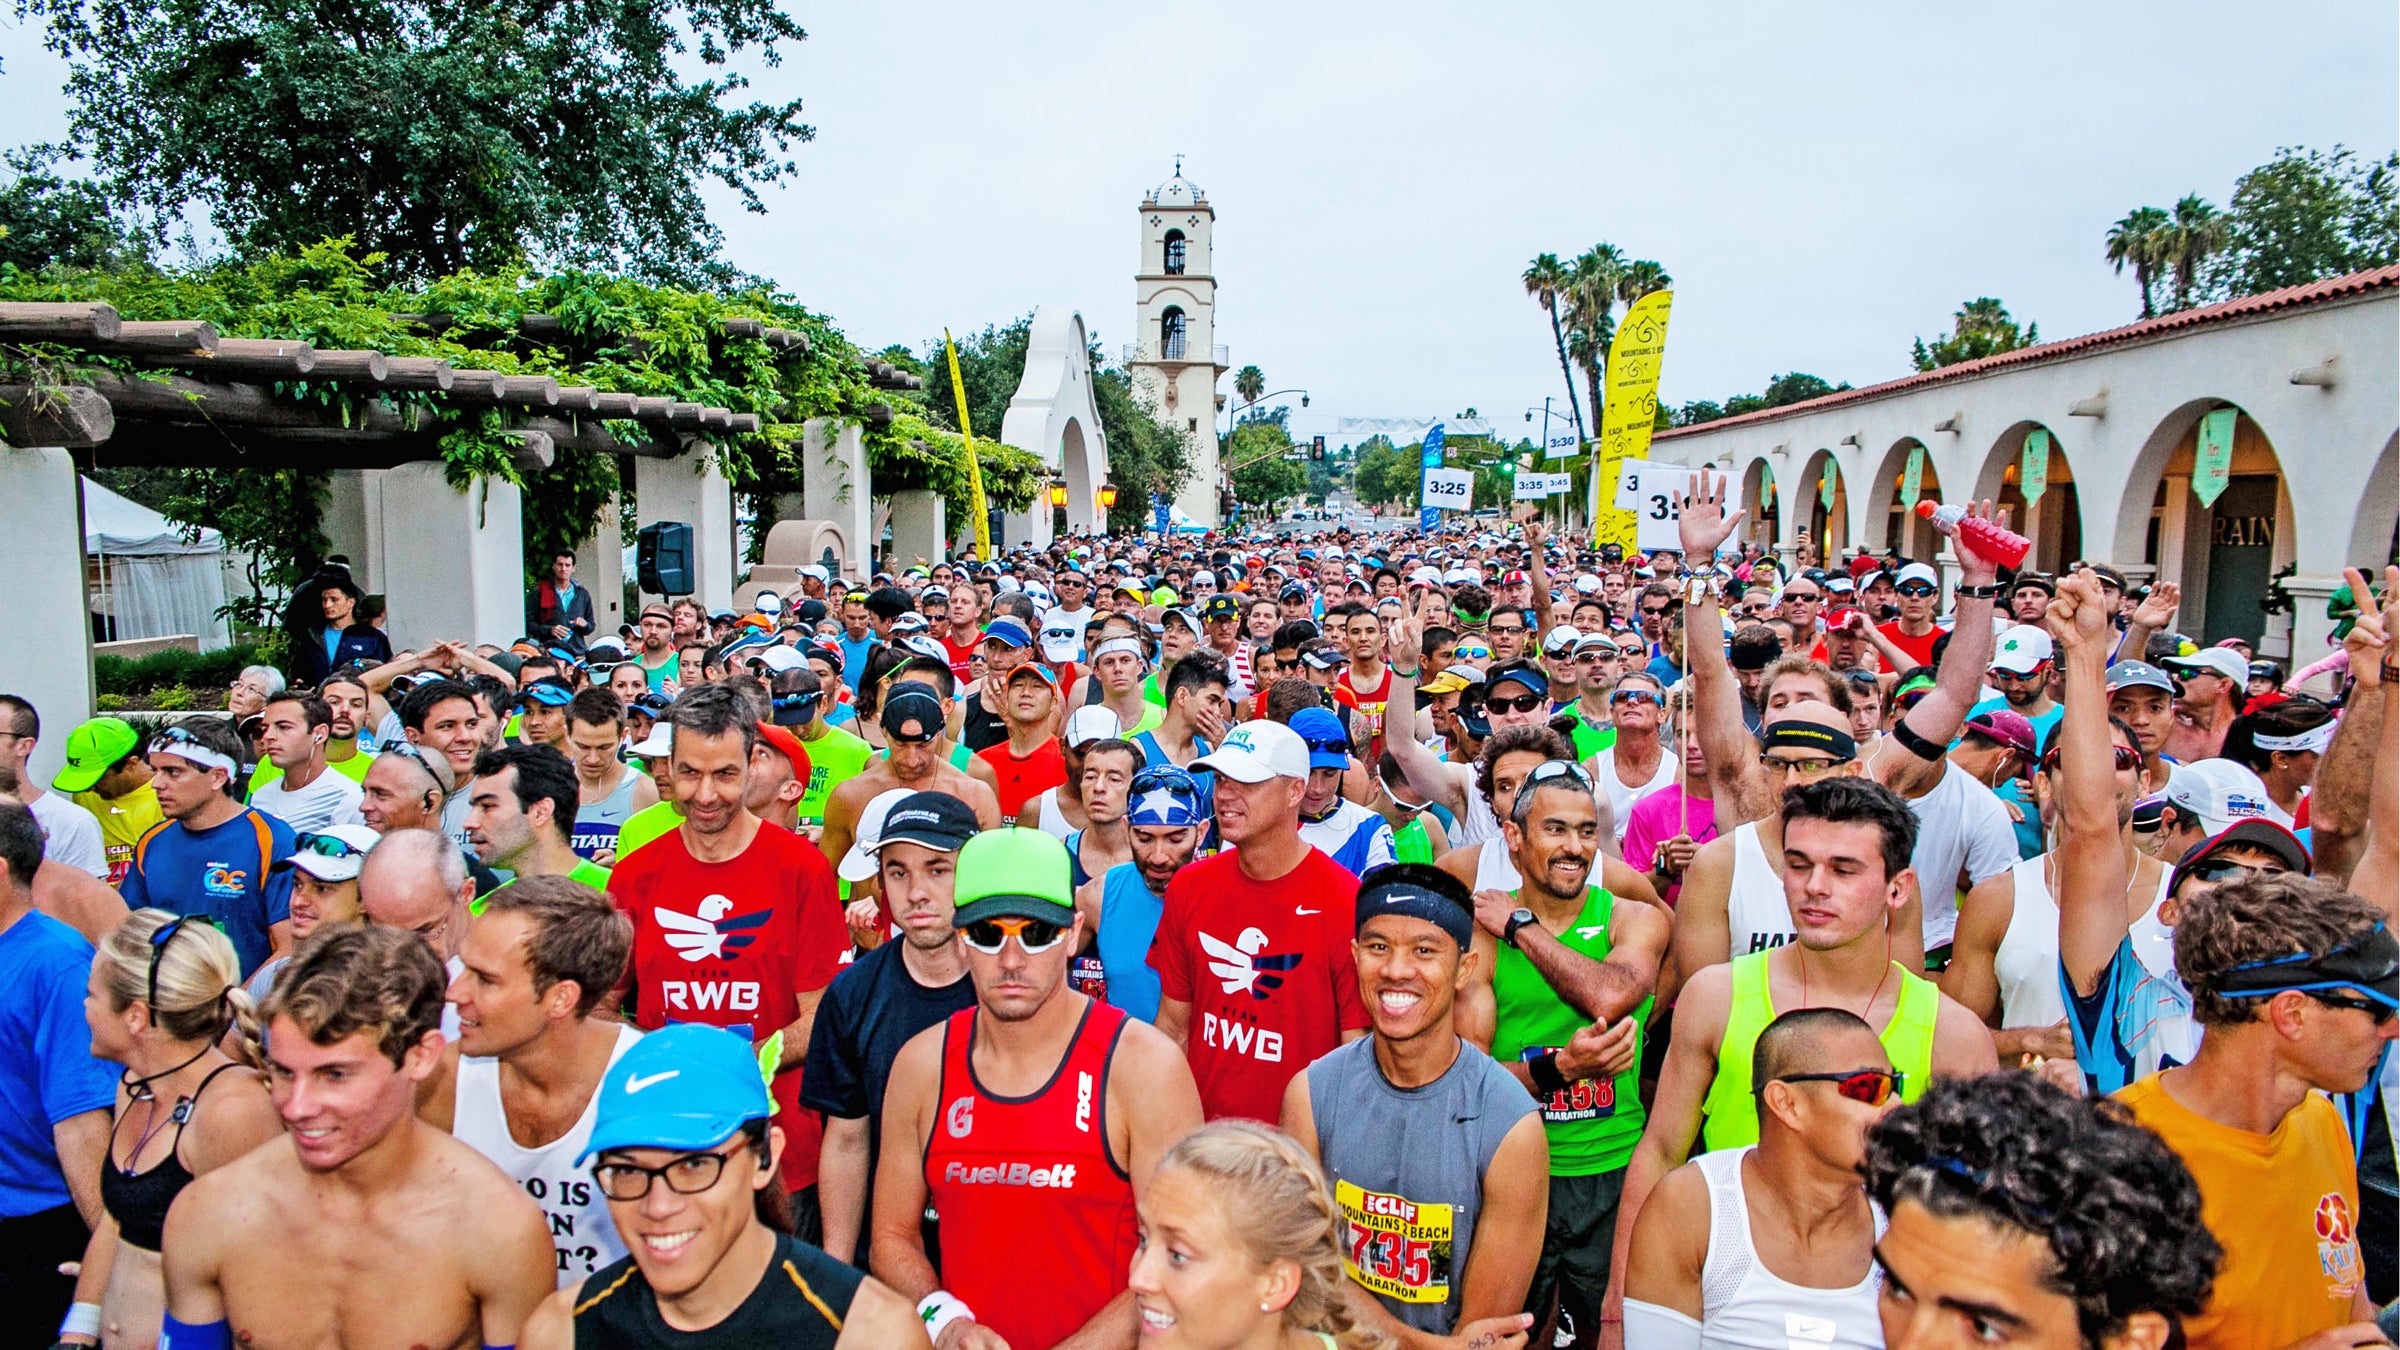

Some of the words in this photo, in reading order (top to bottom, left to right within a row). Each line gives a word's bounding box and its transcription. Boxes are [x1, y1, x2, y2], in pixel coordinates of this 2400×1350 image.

[1550, 436, 1575, 448] 3:30
[1430, 480, 1466, 496] 3:25
[1518, 480, 1543, 490] 3:35
[1549, 478, 1568, 487] 3:45
[1649, 494, 1725, 521] 3:
[690, 969, 729, 978] TEAM
[662, 981, 760, 1011] RWB
[1203, 1011, 1283, 1063] RWB
[1542, 1074, 1614, 1112] 158
[1545, 1109, 1596, 1121] MARATHON
[944, 1161, 1077, 1189] FuelBelt
[559, 1181, 591, 1207] IS
[1403, 1222, 1408, 1235] 2
[1410, 1226, 1449, 1240] BEACH
[1350, 1221, 1432, 1288] 735
[1358, 1270, 1418, 1299] MARATHON
